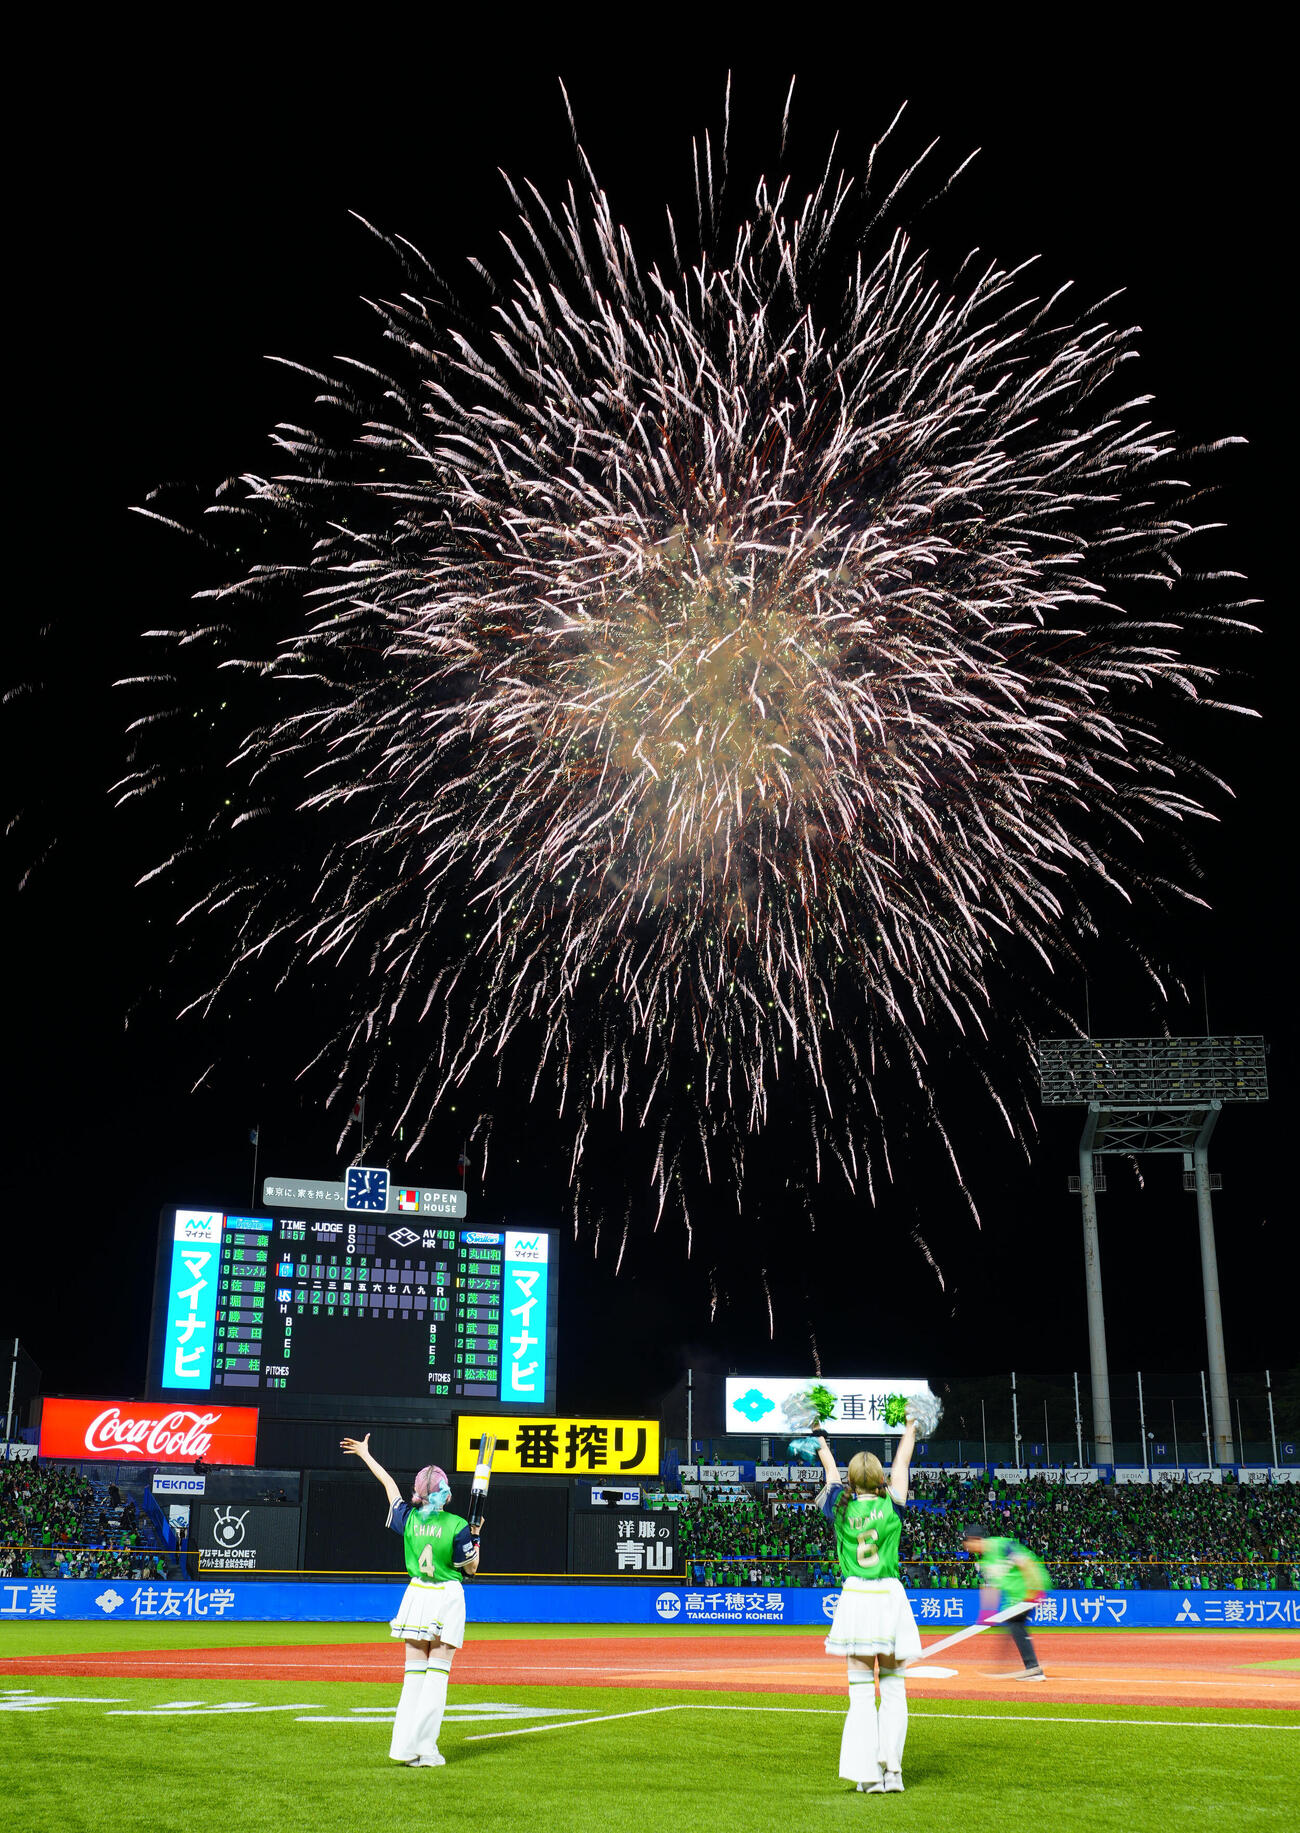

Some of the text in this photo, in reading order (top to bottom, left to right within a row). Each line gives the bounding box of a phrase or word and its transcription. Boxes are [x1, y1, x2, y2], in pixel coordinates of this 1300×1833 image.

[266, 1187, 344, 1201] 東京に、家を持とう。
[424, 1192, 457, 1203] OPEN
[424, 1204, 457, 1212] HOUSE
[280, 1220, 343, 1232] TIME JUDGE
[348, 1224, 356, 1234] B
[185, 1230, 212, 1238] マイナビ
[280, 1230, 305, 1240] 1:57
[348, 1234, 356, 1244] S
[423, 1230, 455, 1240] AV 409
[347, 1244, 355, 1254] O
[422, 1240, 454, 1250] HR 0
[284, 1253, 290, 1262] H
[515, 1250, 539, 1258] マイナビ
[232, 1264, 266, 1277] ヒュンメル
[298, 1265, 307, 1277] 0
[329, 1266, 337, 1278] 0
[344, 1268, 352, 1280] 2
[359, 1268, 367, 1280] 2
[436, 1272, 444, 1285] 5
[231, 1280, 265, 1293] 佐野
[468, 1278, 500, 1290] サンタナ
[373, 1284, 382, 1292] 六
[388, 1285, 396, 1293] 七
[403, 1285, 410, 1294] 八
[418, 1286, 426, 1294] 九
[437, 1287, 444, 1296] R
[297, 1290, 304, 1302] 4
[313, 1292, 320, 1303] 2
[328, 1292, 335, 1304] 0
[343, 1293, 350, 1304] 3
[433, 1298, 447, 1310] 10
[175, 1250, 212, 1378] マイナビ
[280, 1304, 287, 1313] H
[467, 1308, 499, 1320] 内山
[286, 1317, 292, 1326] B
[228, 1327, 262, 1339] 京田
[285, 1327, 291, 1336] 0
[430, 1324, 436, 1333] B
[510, 1270, 540, 1391] マイナビ
[284, 1339, 291, 1348] E
[430, 1334, 436, 1343] 3
[466, 1338, 498, 1350] 古賀
[238, 1343, 249, 1354] 林
[284, 1349, 290, 1358] 0
[429, 1346, 436, 1355] E
[428, 1356, 435, 1364] 2
[465, 1354, 498, 1366] 田中
[266, 1366, 289, 1376] PITCHES
[275, 1378, 286, 1388] 15
[429, 1373, 450, 1383] PITCHES
[436, 1385, 448, 1395] 82
[85, 1408, 222, 1456] Coca-Cola
[470, 1424, 646, 1469] 一番搾り
[1157, 1445, 1165, 1454] H
[1285, 1444, 1293, 1454] G
[154, 1480, 204, 1490] TEKNOS
[593, 1492, 638, 1500] TOS
[414, 1525, 442, 1538] CHIKA
[618, 1520, 670, 1538] 洋服の
[857, 1528, 880, 1568] 6
[615, 1540, 673, 1570] 青山
[418, 1544, 435, 1578] 4
[0, 1585, 57, 1614] 工業
[131, 1587, 235, 1616] 住友化学
[685, 1593, 784, 1611] 高千穂交易
[657, 1600, 680, 1611] TK
[1026, 1595, 1127, 1622] 藤ハザマ
[1204, 1600, 1300, 1622] 三菱ガス化
